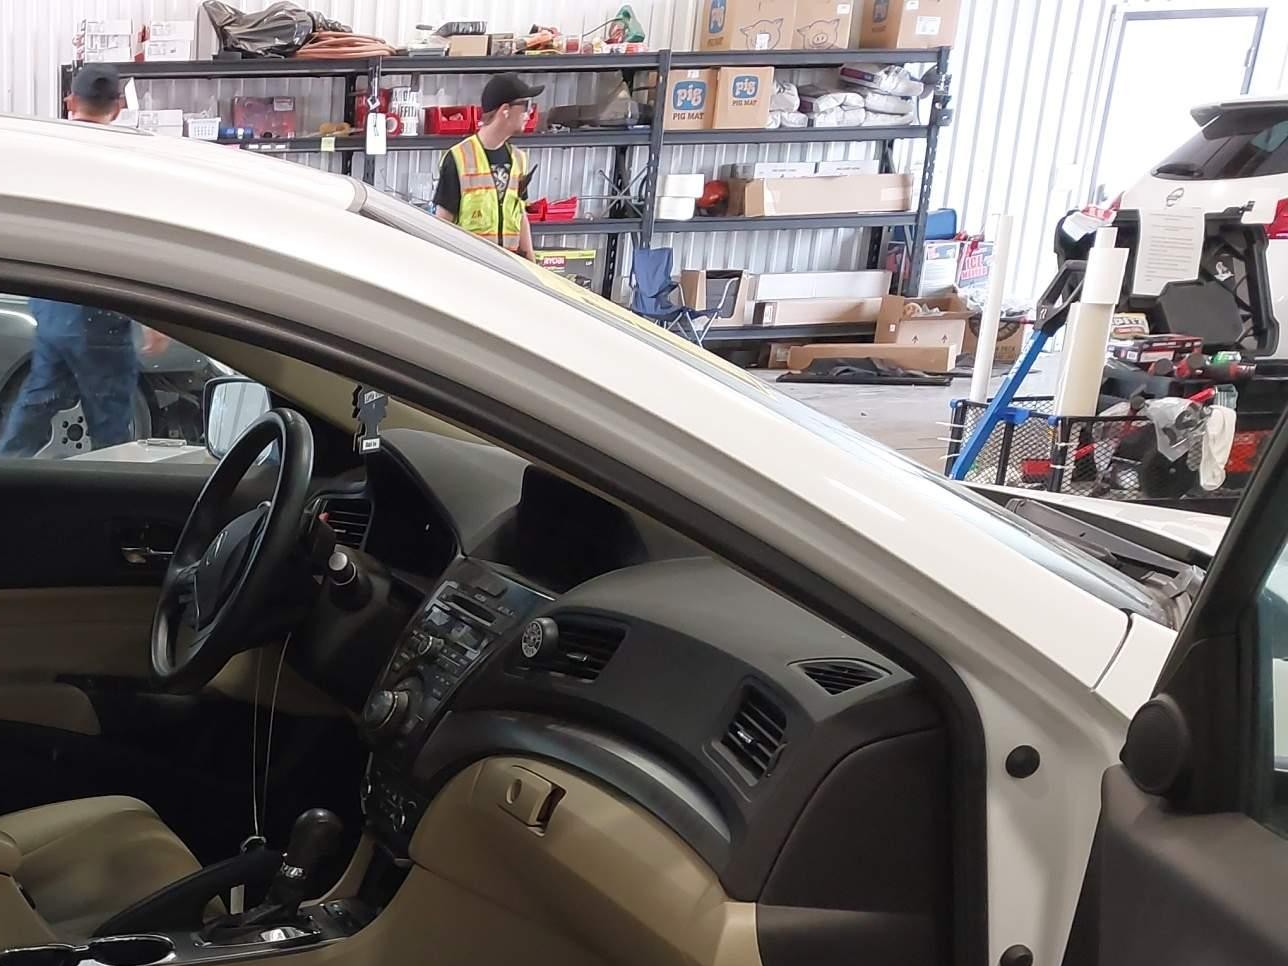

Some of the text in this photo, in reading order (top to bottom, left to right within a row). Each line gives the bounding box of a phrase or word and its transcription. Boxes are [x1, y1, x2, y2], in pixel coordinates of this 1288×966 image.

[735, 77, 756, 96] pig
[676, 84, 703, 107] pig
[672, 112, 705, 121] PIG MAT
[543, 257, 565, 265] RYOBI
